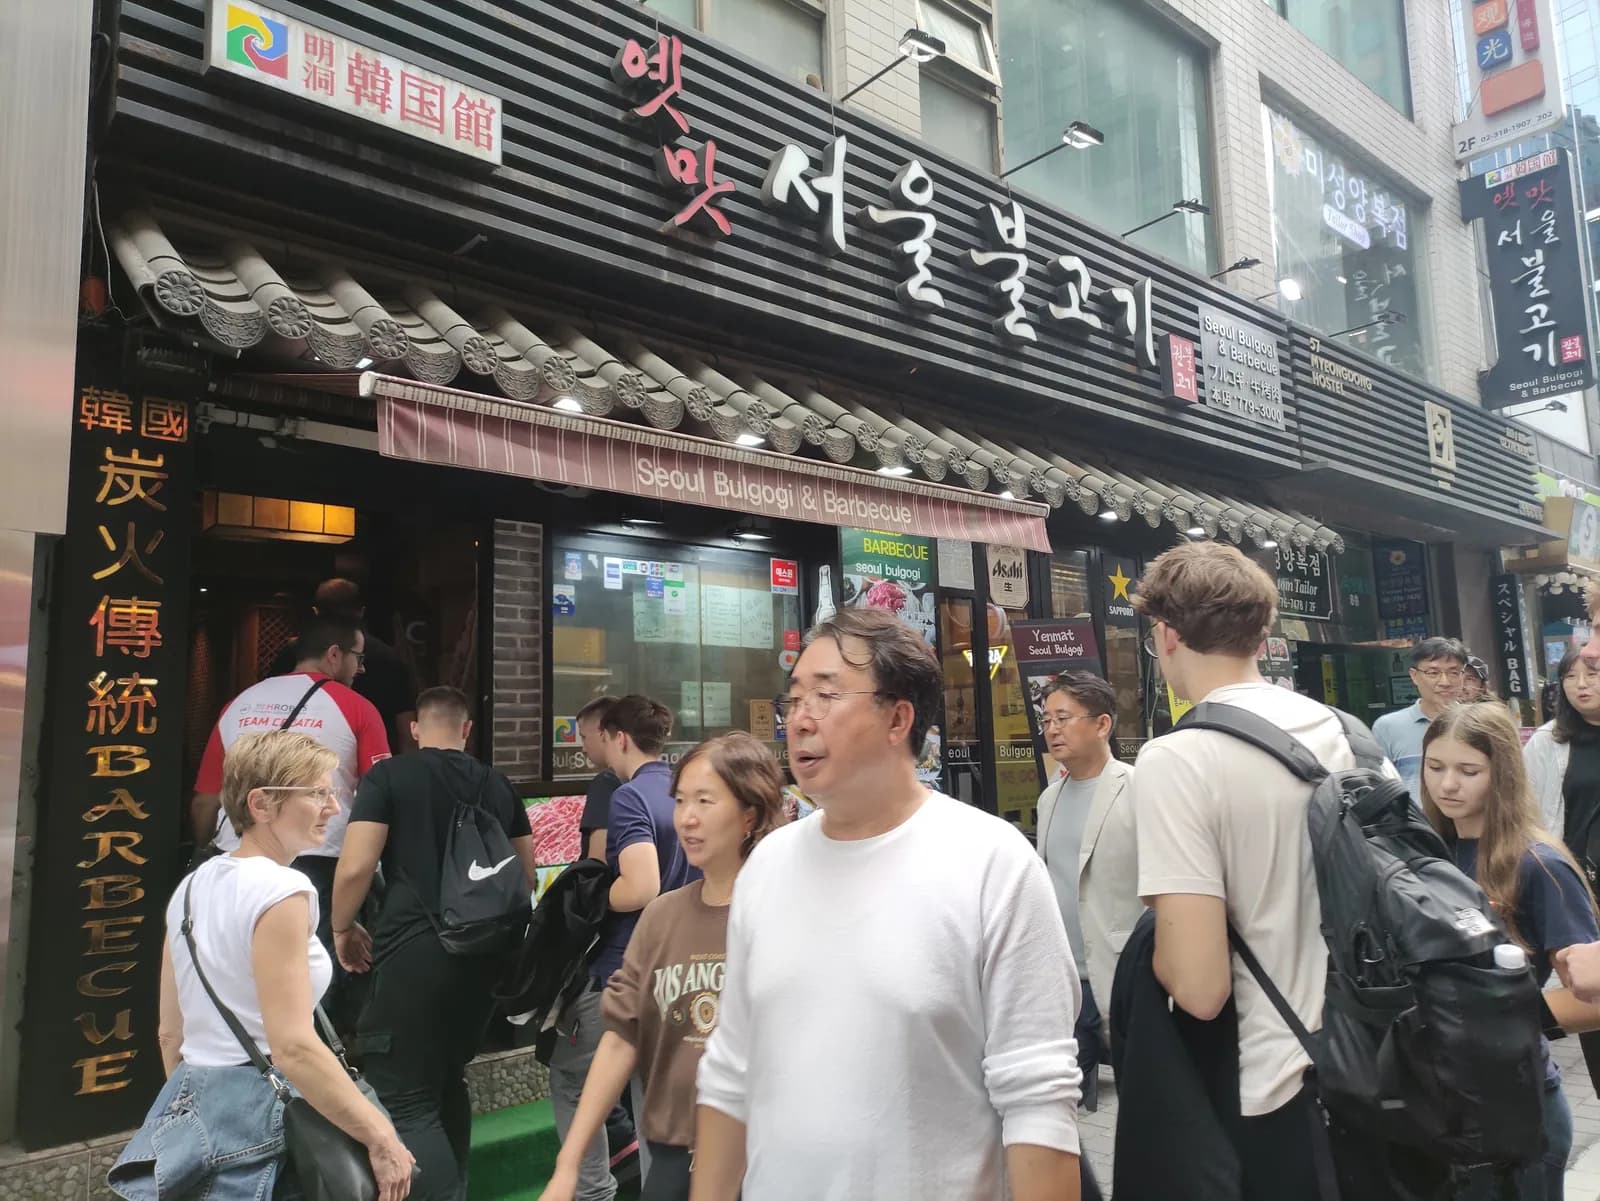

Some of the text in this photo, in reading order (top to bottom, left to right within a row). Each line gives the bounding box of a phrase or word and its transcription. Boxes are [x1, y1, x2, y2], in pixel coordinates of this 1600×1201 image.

[303, 31, 496, 152] 明洞 韓国館
[1459, 136, 1477, 154] 2F
[1205, 315, 1276, 359] Seoul Bulgogi
[1310, 337, 1320, 353] 57
[1219, 339, 1279, 376] & Barbecue
[1311, 353, 1373, 392] MYEONGDONG
[1311, 370, 1346, 396] HOSTEL
[1509, 369, 1584, 391] Seoul Bulgogi
[1533, 378, 1585, 396] Barbecue
[79, 384, 189, 444] 韓國
[637, 457, 912, 524] Seoul Bulgogi & Barbecue
[863, 537, 929, 561] BARBECUE
[855, 562, 921, 581] seoul bulgogi
[992, 559, 1023, 580] Asahi
[1004, 582, 1013, 593] 生
[1108, 605, 1134, 617] SAPPORO
[1032, 628, 1075, 643] Yenmat
[1028, 643, 1084, 657] Seoul Bulgogi
[1507, 658, 1521, 693] BAG
[239, 717, 269, 729] TEAM
[1000, 744, 1035, 760] Bulgogi
[71, 744, 151, 1097] BARBECUE
